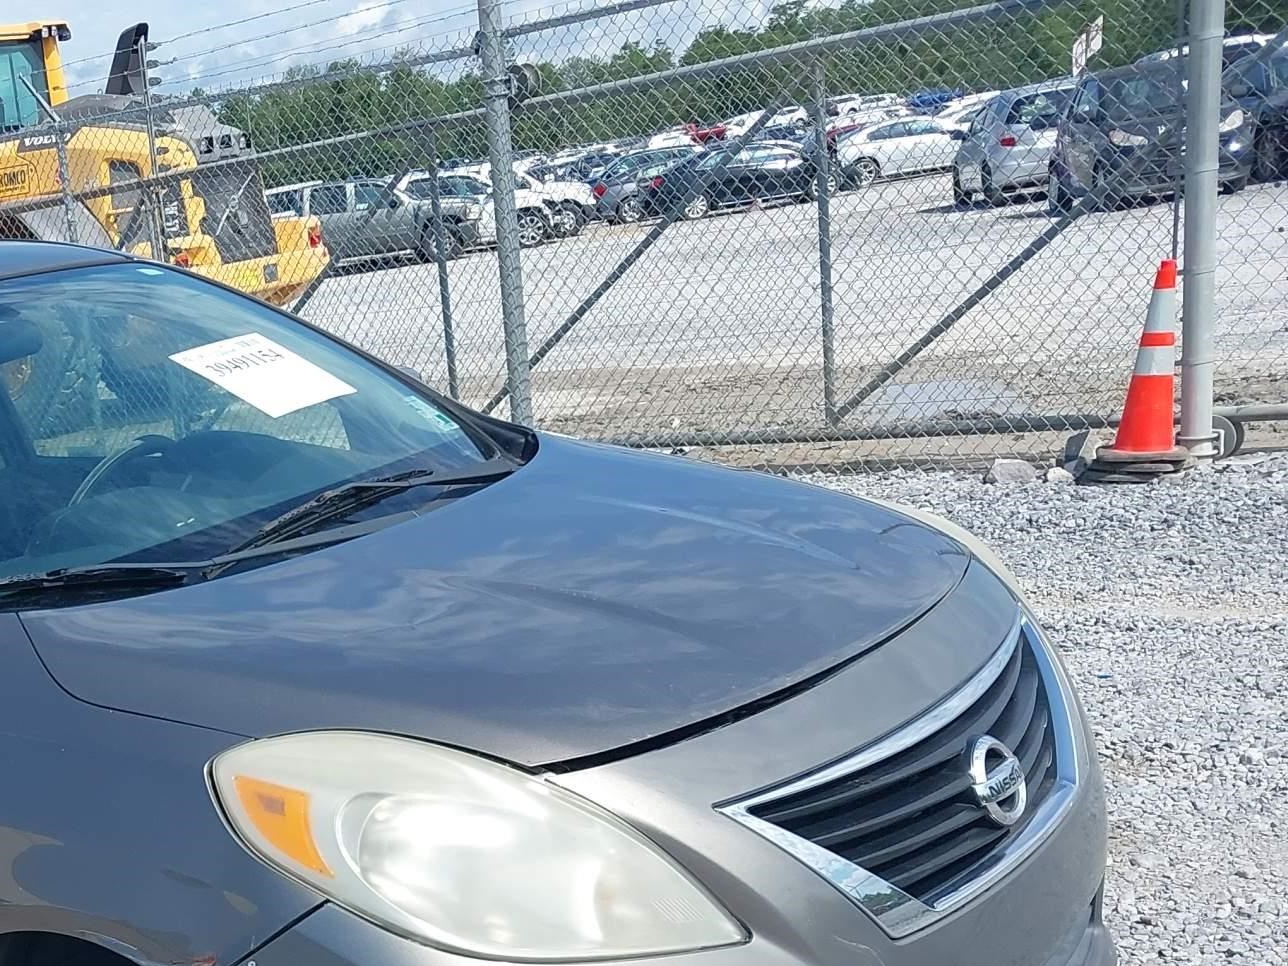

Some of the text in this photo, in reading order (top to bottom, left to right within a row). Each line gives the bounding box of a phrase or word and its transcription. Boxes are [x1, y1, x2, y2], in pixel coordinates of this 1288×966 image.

[24, 133, 71, 147] VOLVO
[205, 348, 286, 377] 39491154
[988, 766, 1023, 799] NISSA
